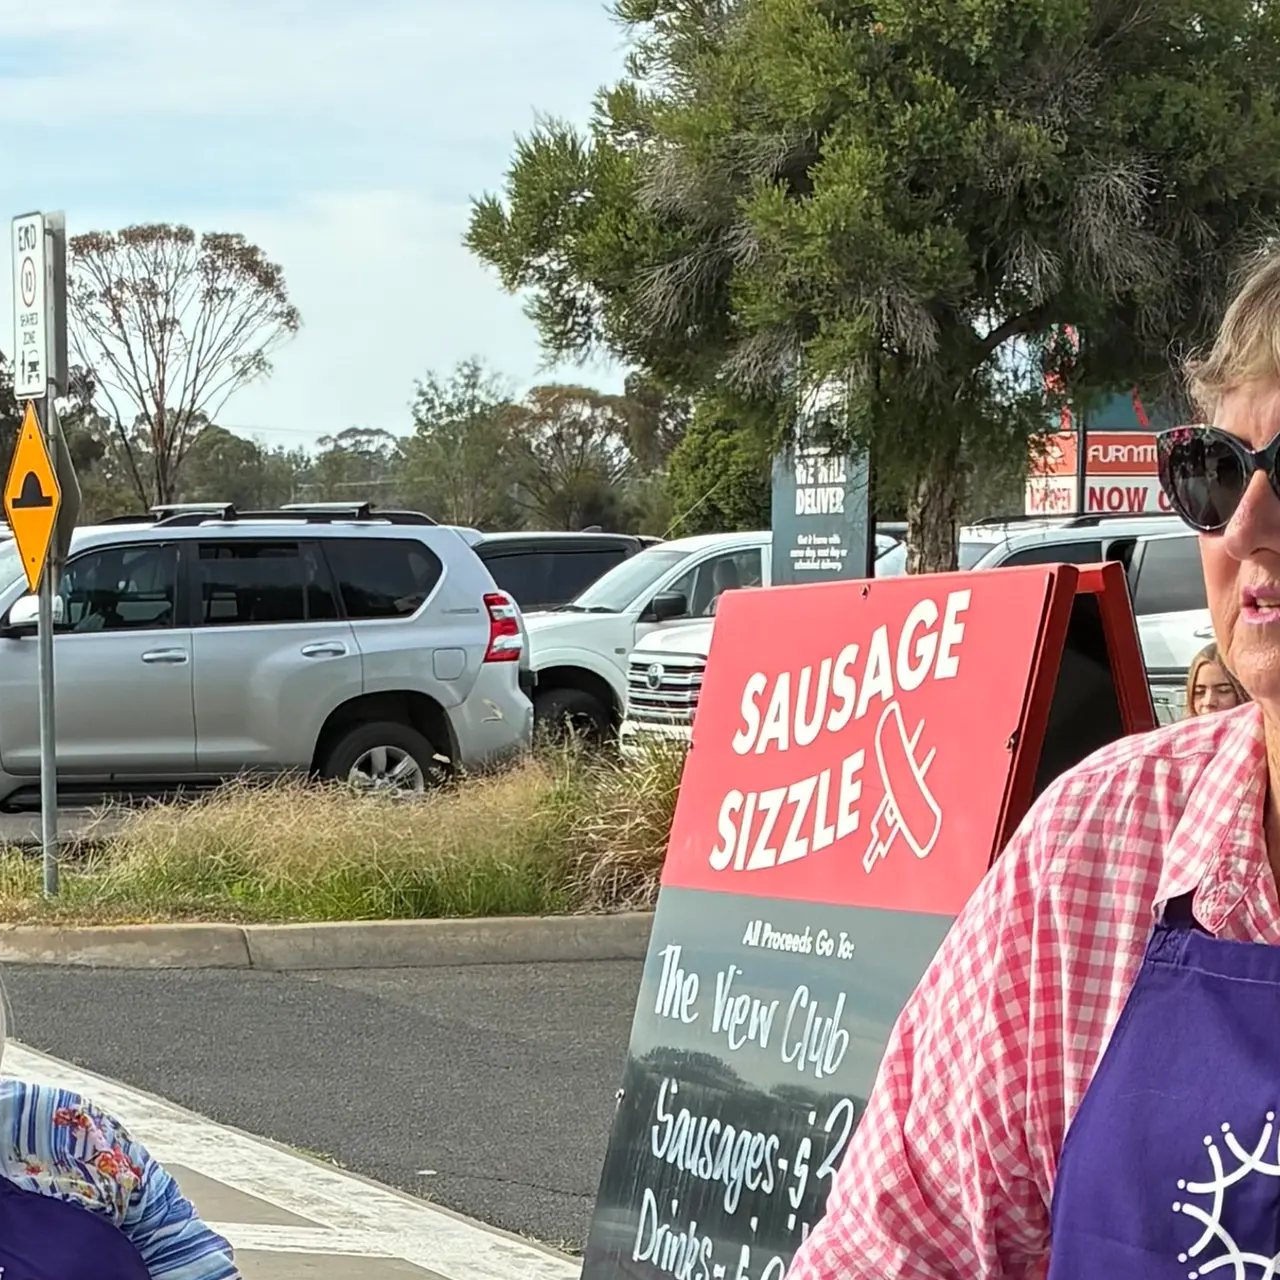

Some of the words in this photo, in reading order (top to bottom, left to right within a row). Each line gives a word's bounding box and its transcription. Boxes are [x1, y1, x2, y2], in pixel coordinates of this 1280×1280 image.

[18, 223, 37, 252] END
[24, 270, 33, 294] 10
[1088, 444, 1158, 463] FURNIT
[795, 486, 845, 515] DELIVER
[1088, 486, 1149, 512] NOW
[731, 588, 972, 755] SAUSAGE
[709, 747, 866, 872] SIZZLE
[742, 919, 763, 948] All
[761, 923, 814, 954] Proceeds
[815, 928, 835, 957] Go
[836, 931, 855, 960] To:
[654, 944, 700, 1024] The
[711, 964, 780, 1051] View
[781, 984, 850, 1079] Club
